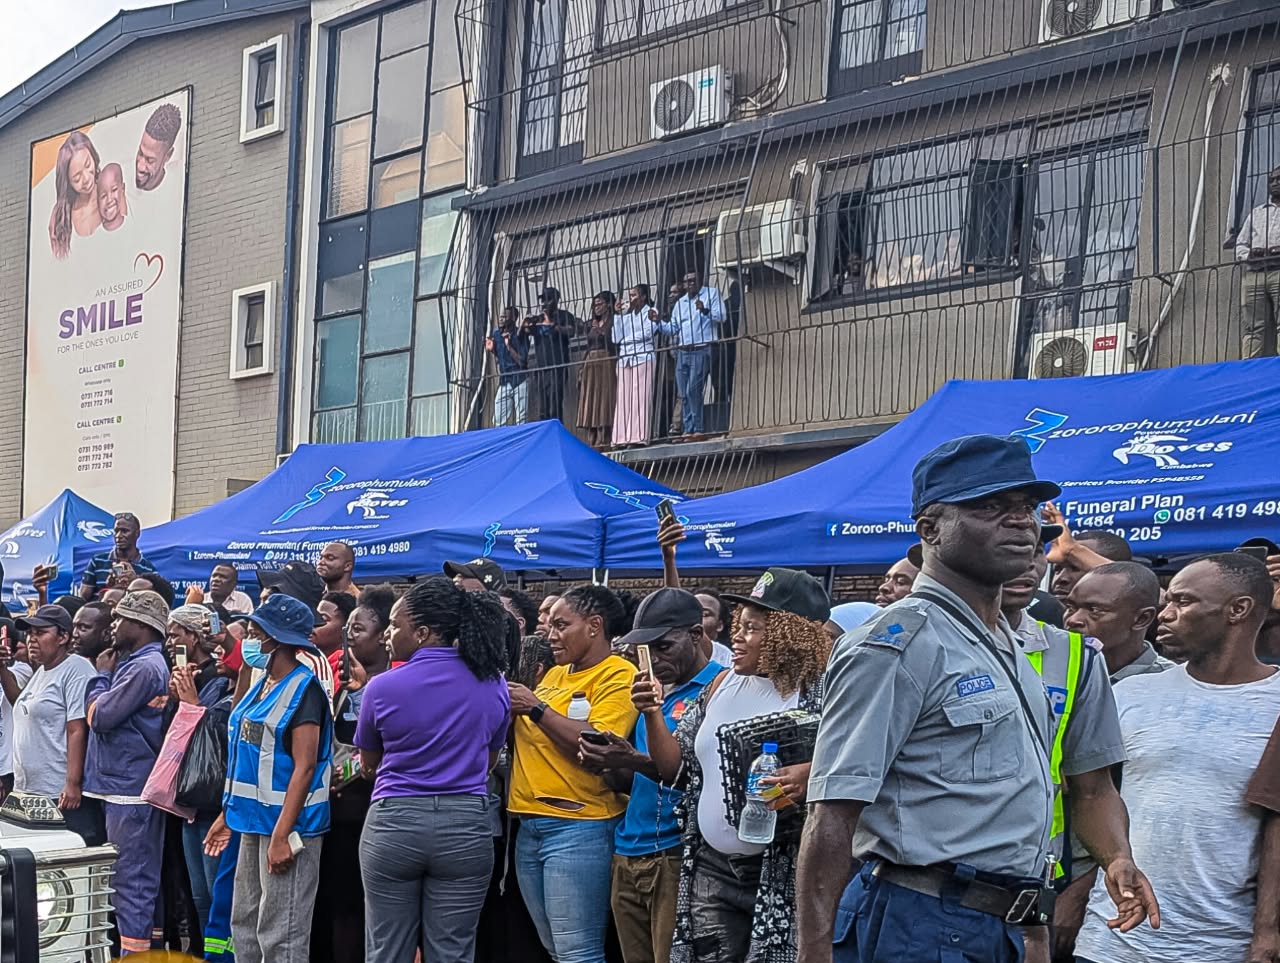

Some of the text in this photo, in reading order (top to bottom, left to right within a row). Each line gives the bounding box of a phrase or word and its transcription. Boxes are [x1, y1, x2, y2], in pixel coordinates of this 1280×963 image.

[95, 279, 143, 297] AN ASSURED
[59, 293, 143, 339] SMILE
[57, 331, 139, 354] FOR THE ONES YOU LOVE
[94, 361, 116, 371] CENTRE
[77, 417, 114, 428] CALL CENTRE
[1048, 410, 1258, 438] zororophumulani
[1131, 441, 1233, 454] Doves
[1066, 496, 1136, 515] Funeral
[1141, 494, 1184, 509] Plan
[1174, 506, 1206, 521] 081
[1212, 503, 1247, 519] 419
[1129, 526, 1162, 541] 205
[370, 545, 386, 555] 419
[388, 541, 410, 552] 4980
[960, 678, 990, 695] POLICE
